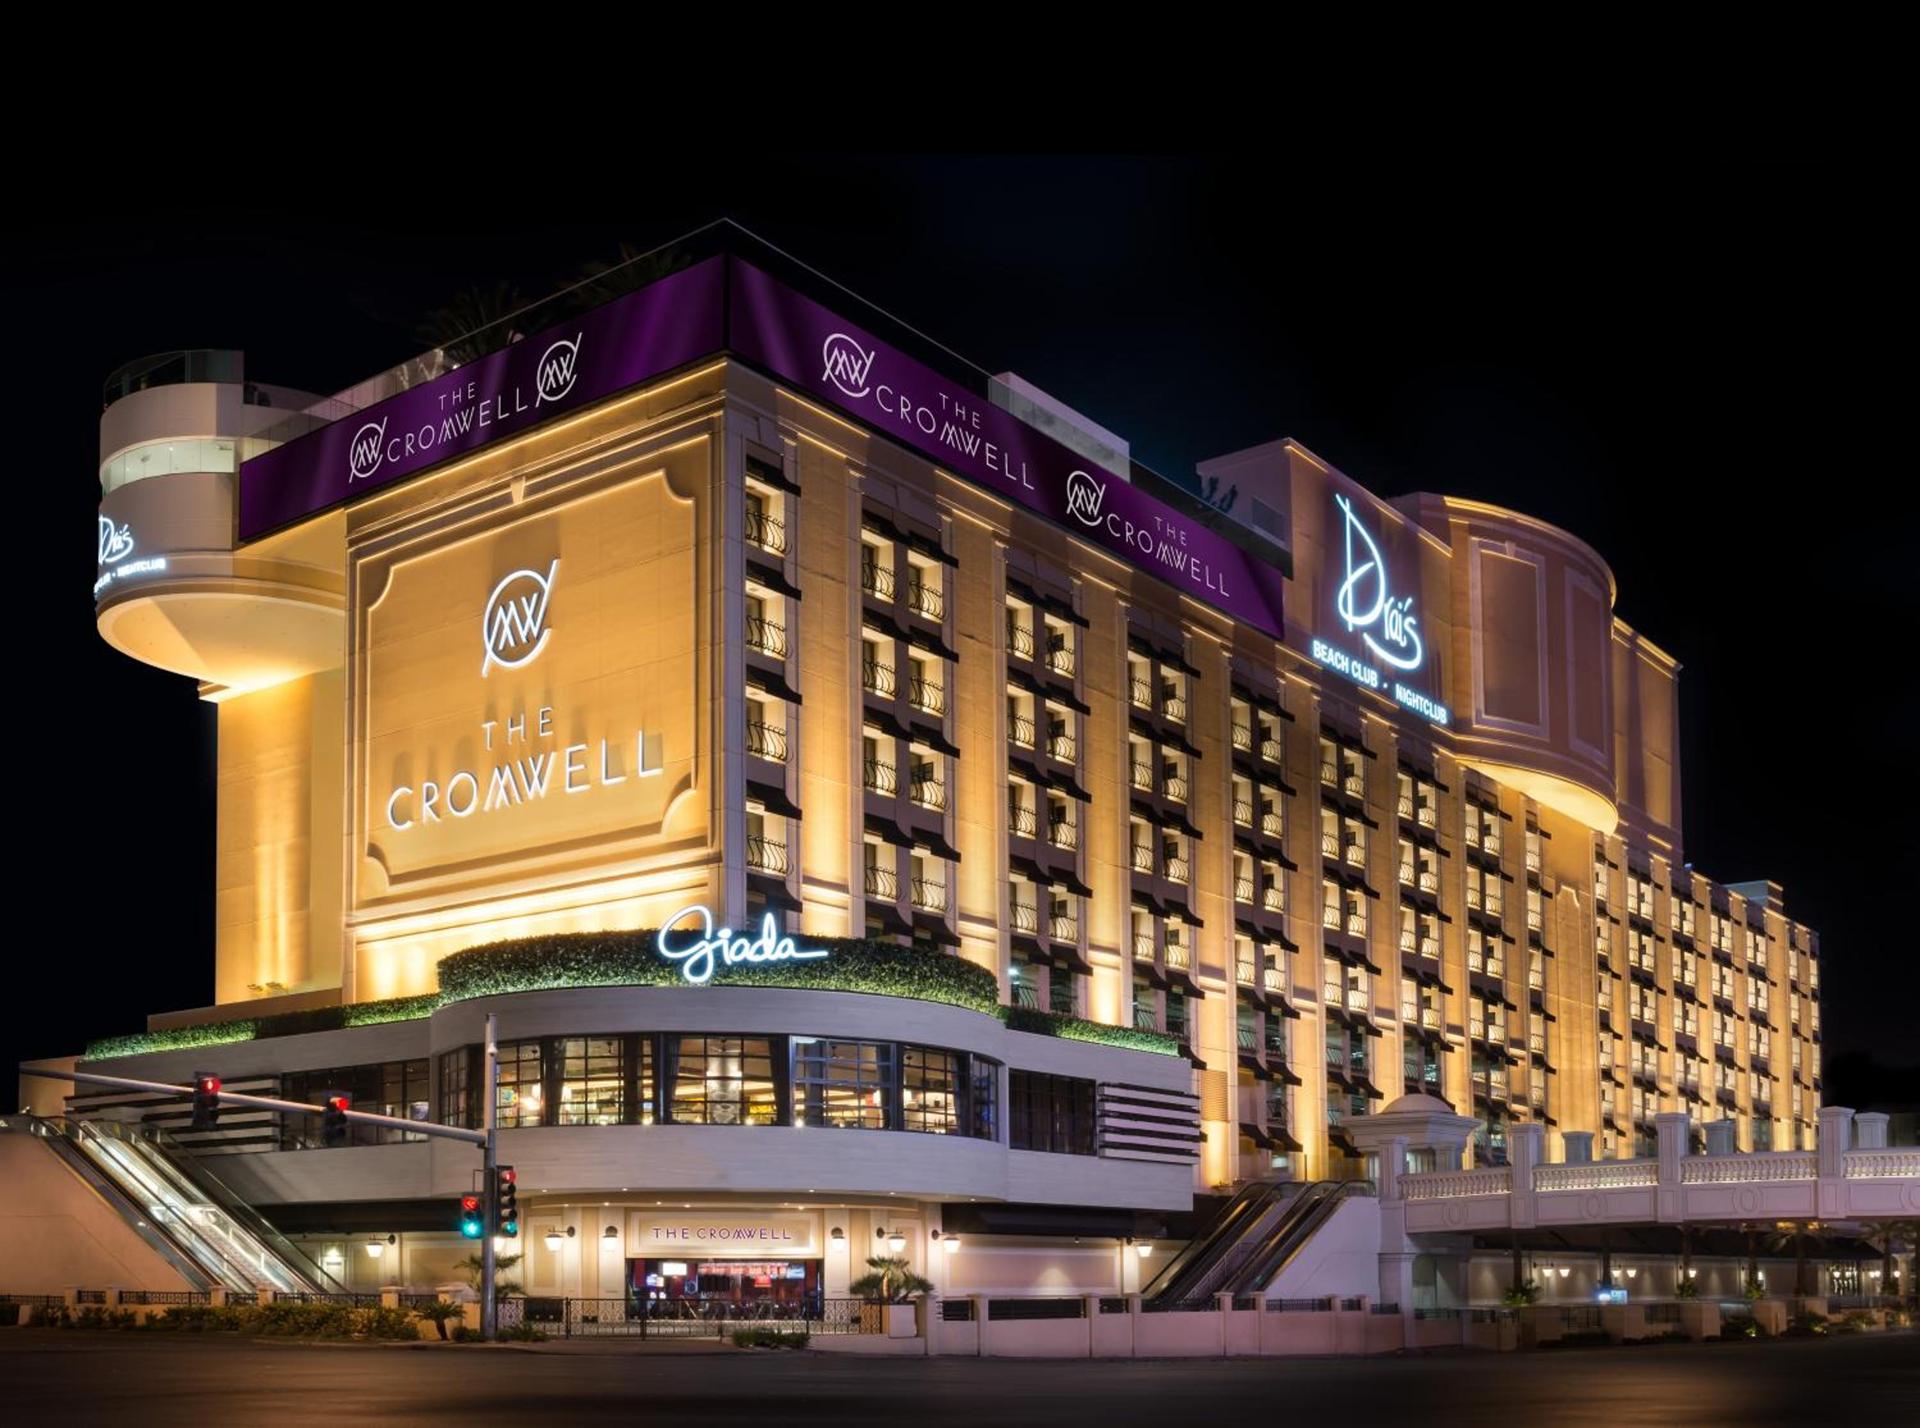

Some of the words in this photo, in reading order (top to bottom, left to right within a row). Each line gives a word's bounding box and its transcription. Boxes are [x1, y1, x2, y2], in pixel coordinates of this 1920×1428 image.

[387, 387, 528, 463] CROMWELL
[438, 382, 476, 411] THE
[938, 392, 981, 430] THE
[876, 385, 1035, 491] CROMWELL
[1106, 513, 1230, 598] CROMWELL
[1154, 516, 1187, 546] THE
[1312, 639, 1349, 674] BEACH
[1351, 660, 1379, 688] CLUB
[1395, 683, 1447, 725] NIGHTCLUB
[481, 706, 554, 751] THE
[387, 728, 664, 831] CROMWELL
[658, 904, 829, 984] Giada
[653, 1227, 690, 1240] THE
[696, 1227, 792, 1240] CROMWELL
